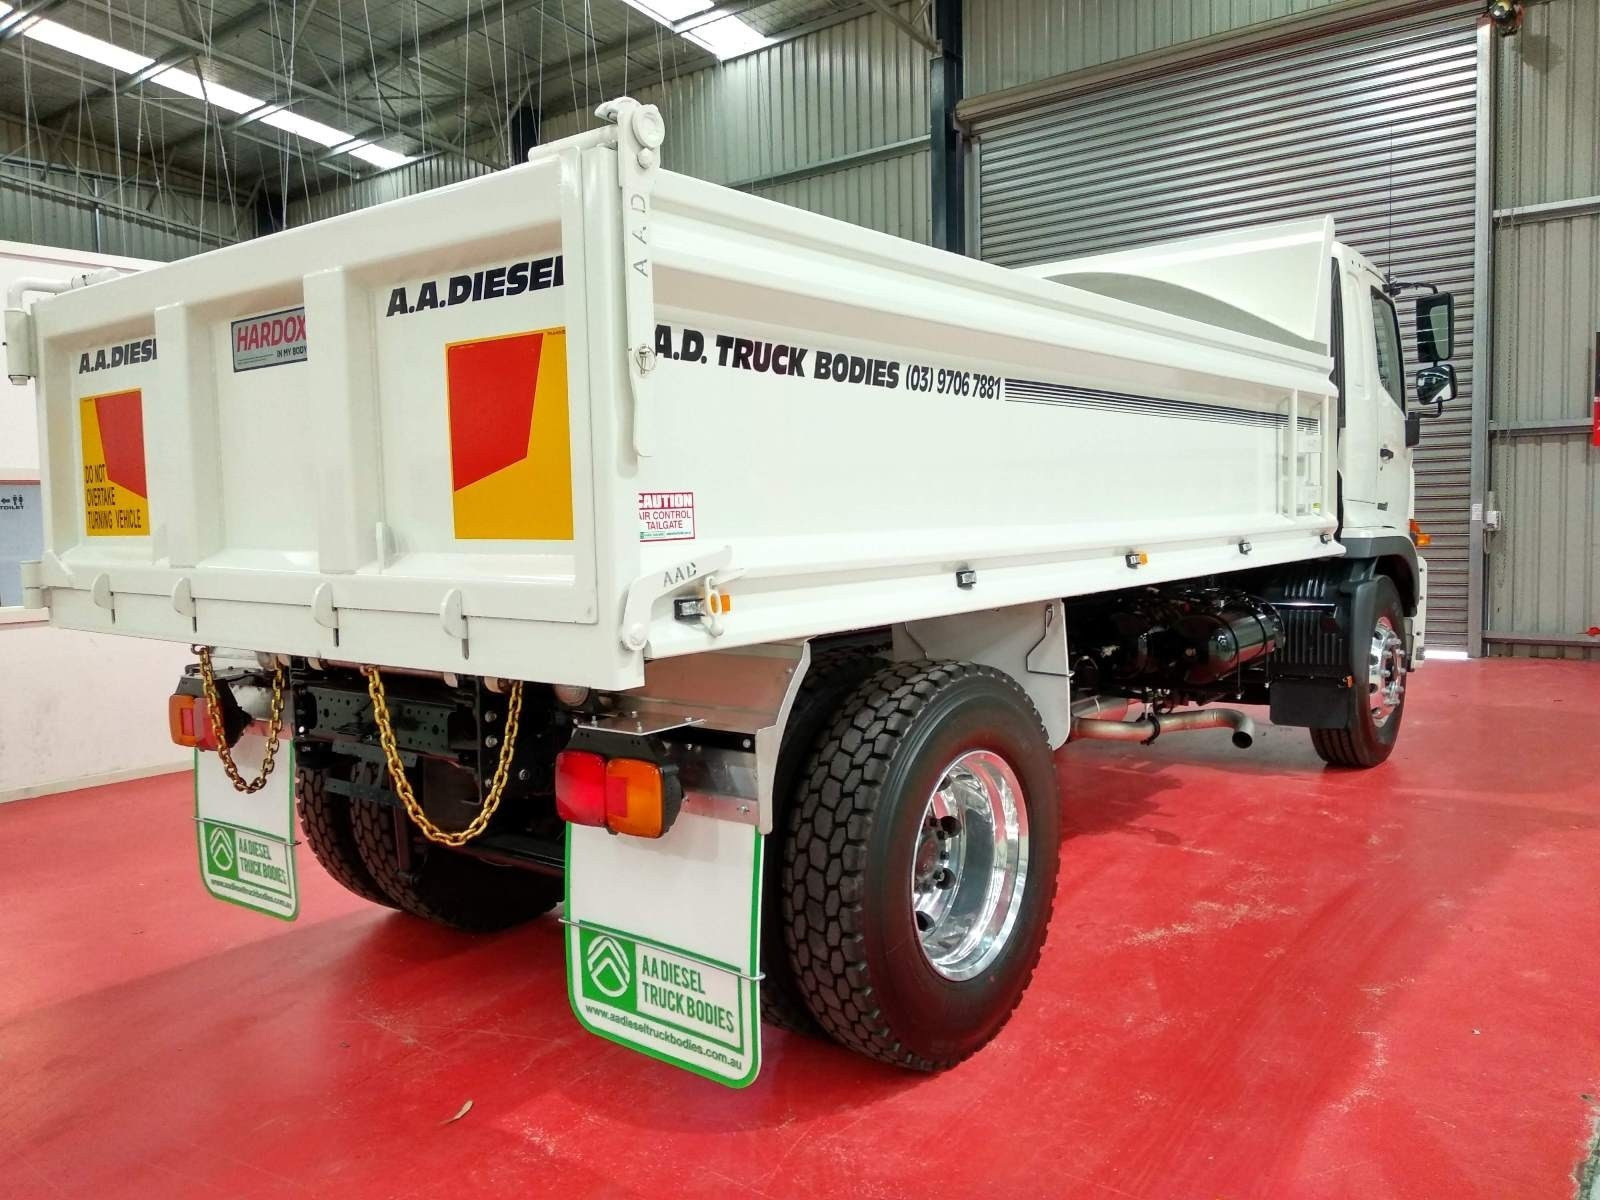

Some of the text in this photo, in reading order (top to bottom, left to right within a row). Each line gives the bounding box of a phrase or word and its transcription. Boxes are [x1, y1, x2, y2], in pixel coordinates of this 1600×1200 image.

[237, 315, 306, 352] HARDOX
[715, 334, 808, 377] TRUCK
[813, 350, 900, 389] BODIES
[905, 363, 934, 393] (03)
[937, 368, 970, 398] 9706
[972, 374, 1001, 401] 7881
[85, 464, 106, 484] DO NOT
[87, 487, 115, 506] OVERTAKE
[88, 509, 142, 529] TURNING VEHICLE
[646, 520, 683, 530] TAILGATE
[653, 510, 692, 520] CONTROL
[660, 960, 706, 995] DIESEL
[642, 981, 734, 1034] TRUCK BODIES
[585, 1004, 742, 1071] www.aadieseltruckbodies.com.au
